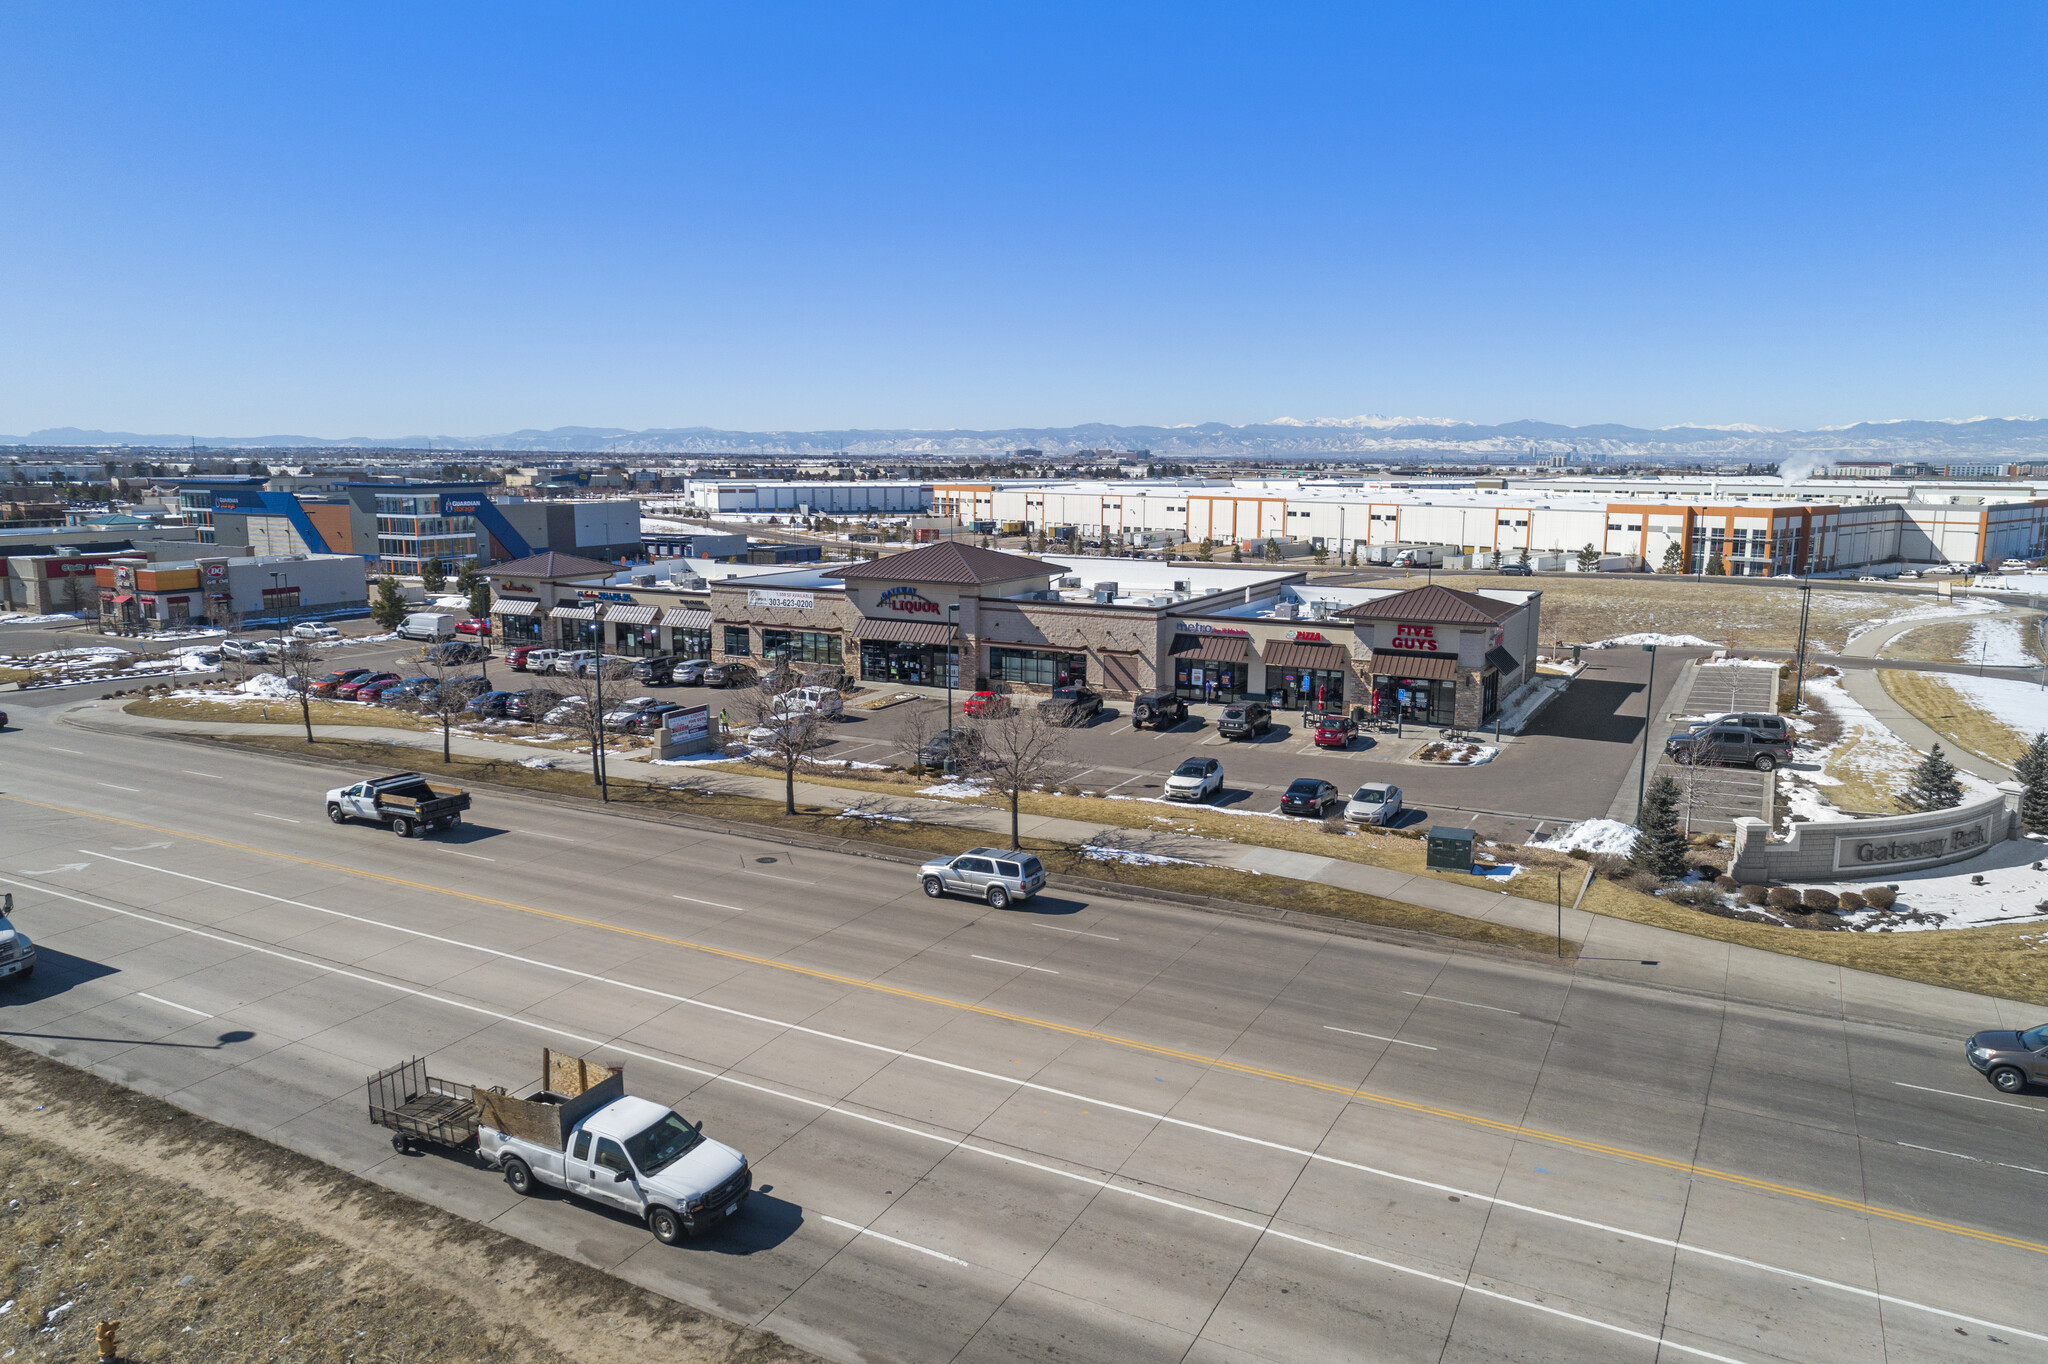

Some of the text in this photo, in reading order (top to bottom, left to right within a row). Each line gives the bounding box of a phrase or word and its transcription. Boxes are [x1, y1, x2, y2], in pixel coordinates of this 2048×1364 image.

[210, 567, 224, 575] DQ
[881, 586, 918, 599] GATEWAY
[768, 598, 813, 608] 303-623-0200
[892, 600, 941, 615] LIQUOR
[1176, 622, 1213, 633] metro
[1397, 624, 1434, 638] FIVE
[1296, 631, 1322, 641] PIZZA
[1391, 637, 1438, 651] GUYS
[1857, 825, 1985, 862] Gateway Park
